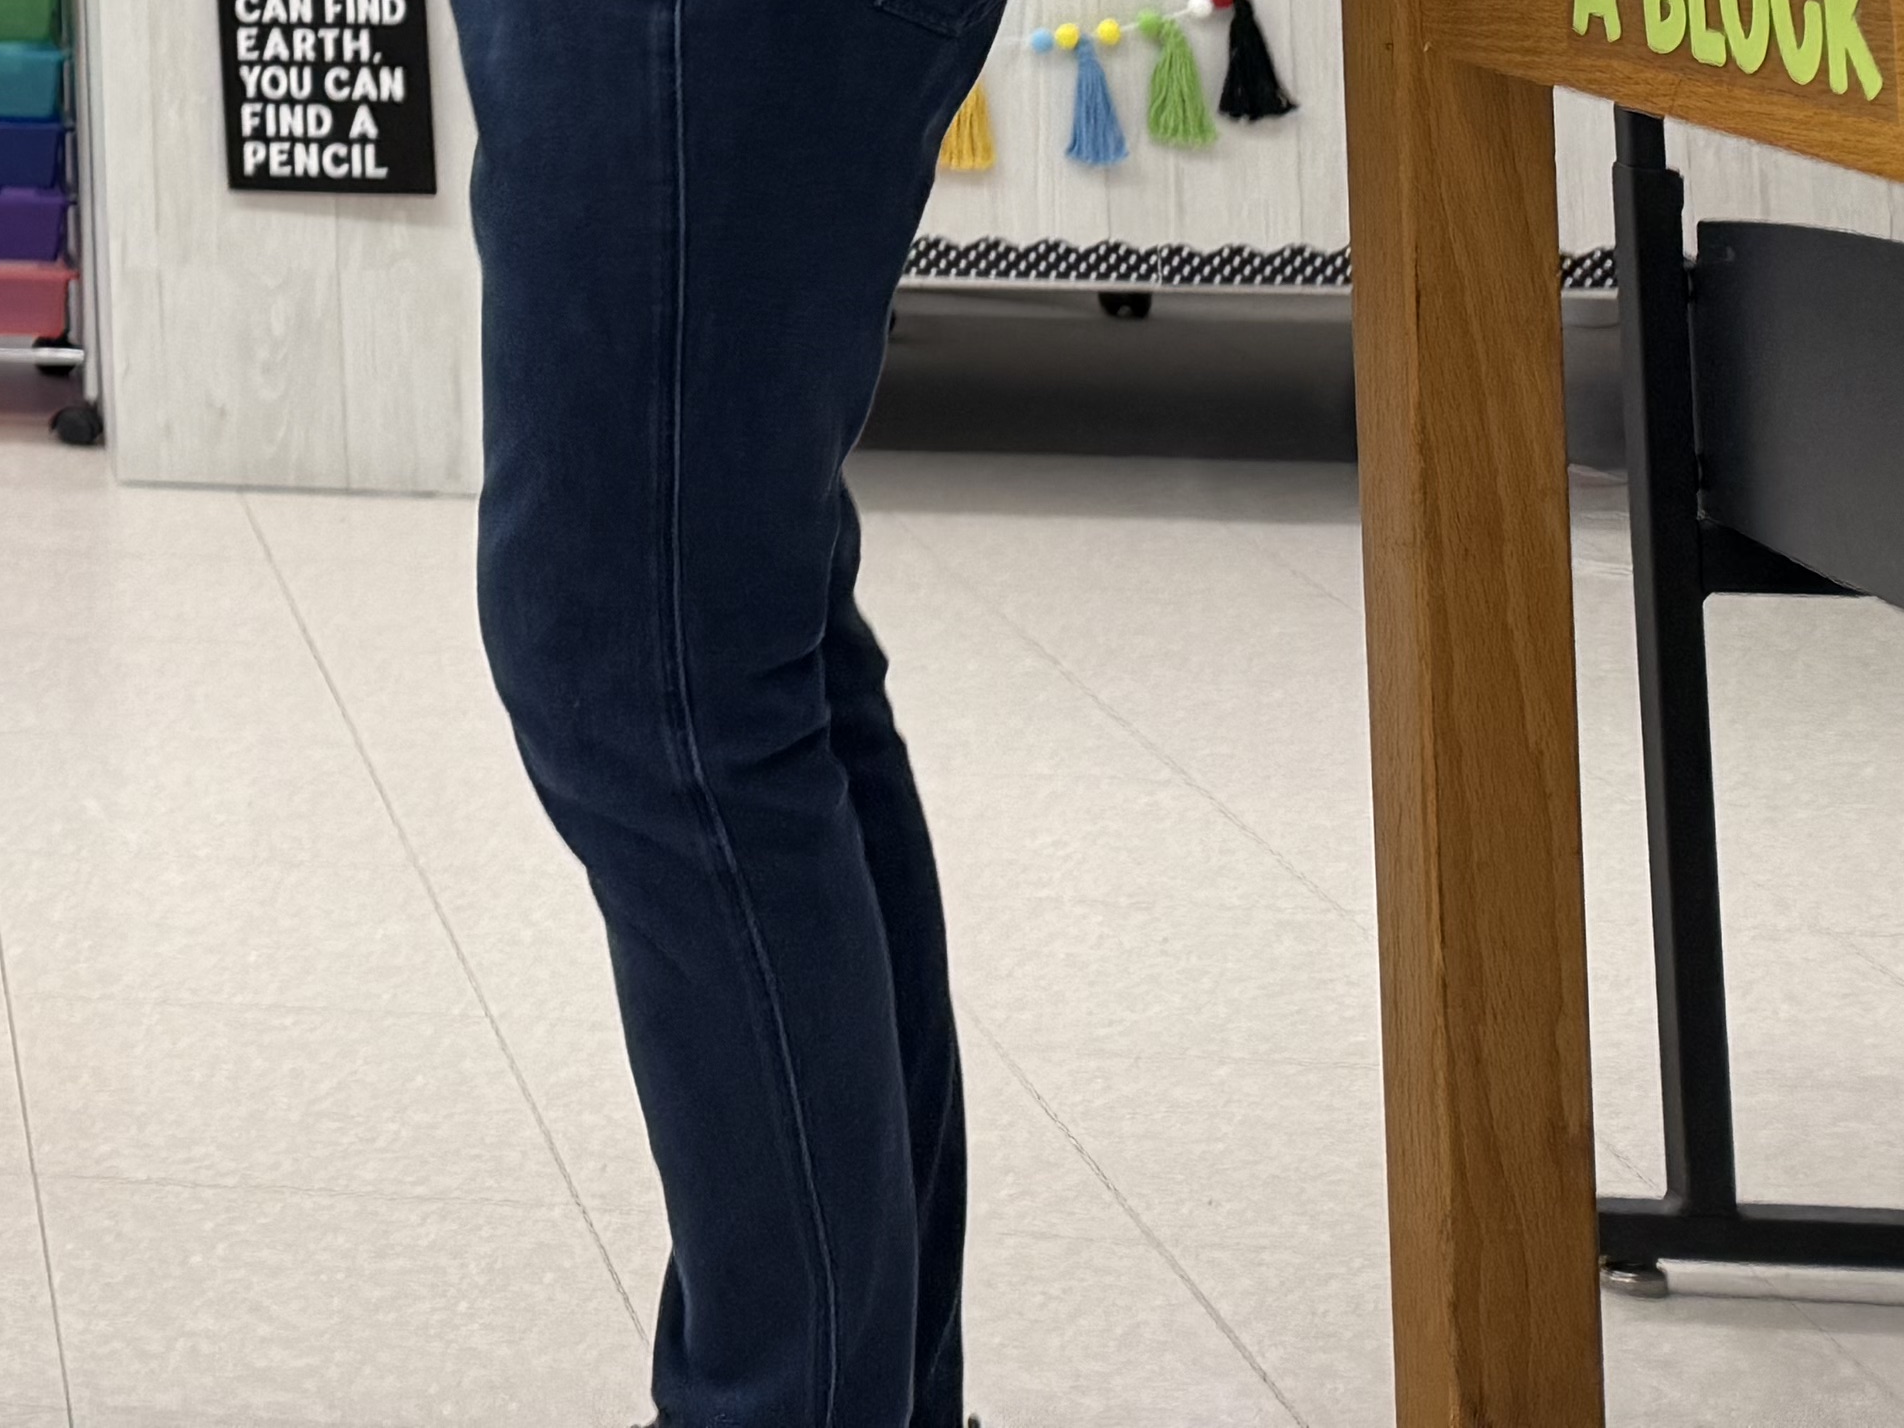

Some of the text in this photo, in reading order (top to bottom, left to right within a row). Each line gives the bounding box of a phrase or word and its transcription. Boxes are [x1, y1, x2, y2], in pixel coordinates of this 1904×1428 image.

[236, 26, 382, 65] EARTH,
[239, 65, 405, 102] YOU CAN
[241, 103, 379, 140] FIND A
[242, 141, 388, 179] PENCIL
